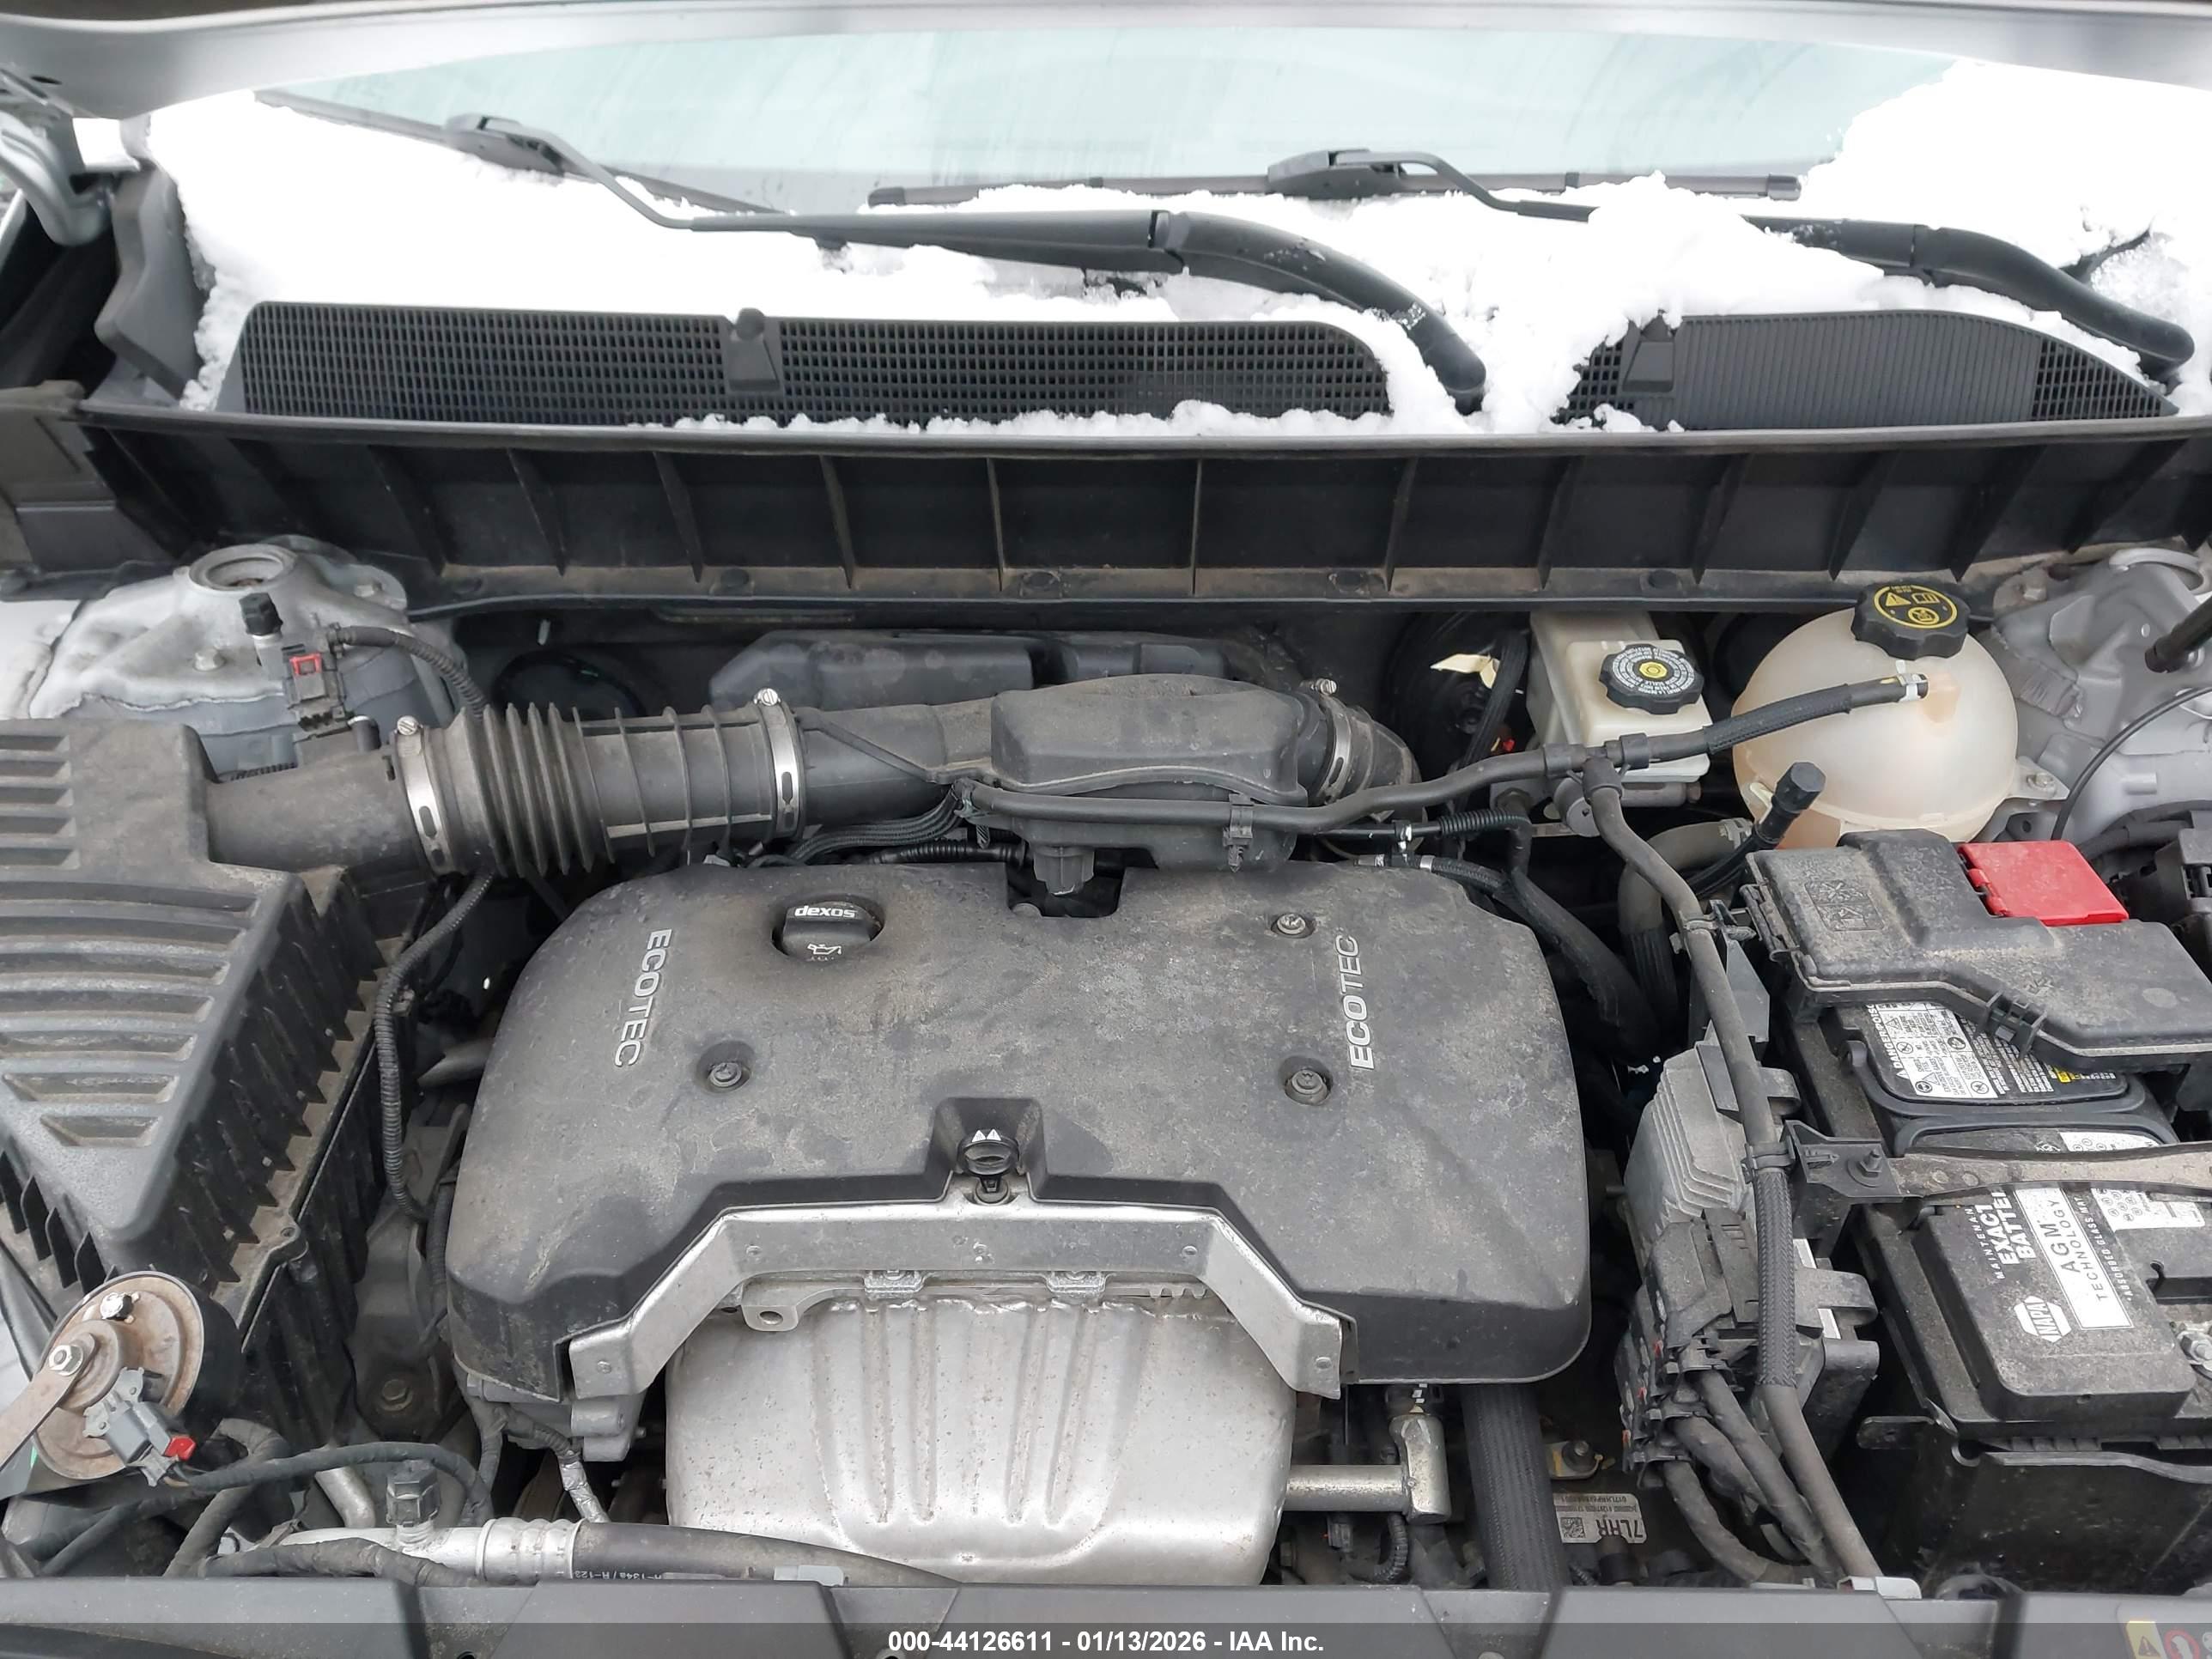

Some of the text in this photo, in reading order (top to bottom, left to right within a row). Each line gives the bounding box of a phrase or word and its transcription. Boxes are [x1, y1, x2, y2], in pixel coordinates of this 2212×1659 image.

[794, 906, 856, 918] dexos
[616, 928, 672, 1066] ECOTEC
[1335, 934, 1374, 1069] ECOTEC
[2047, 1199, 2109, 1301] TECHNOLOGY
[2084, 1216, 2106, 1245] GLASS
[2025, 1303, 2063, 1336] NAPA
